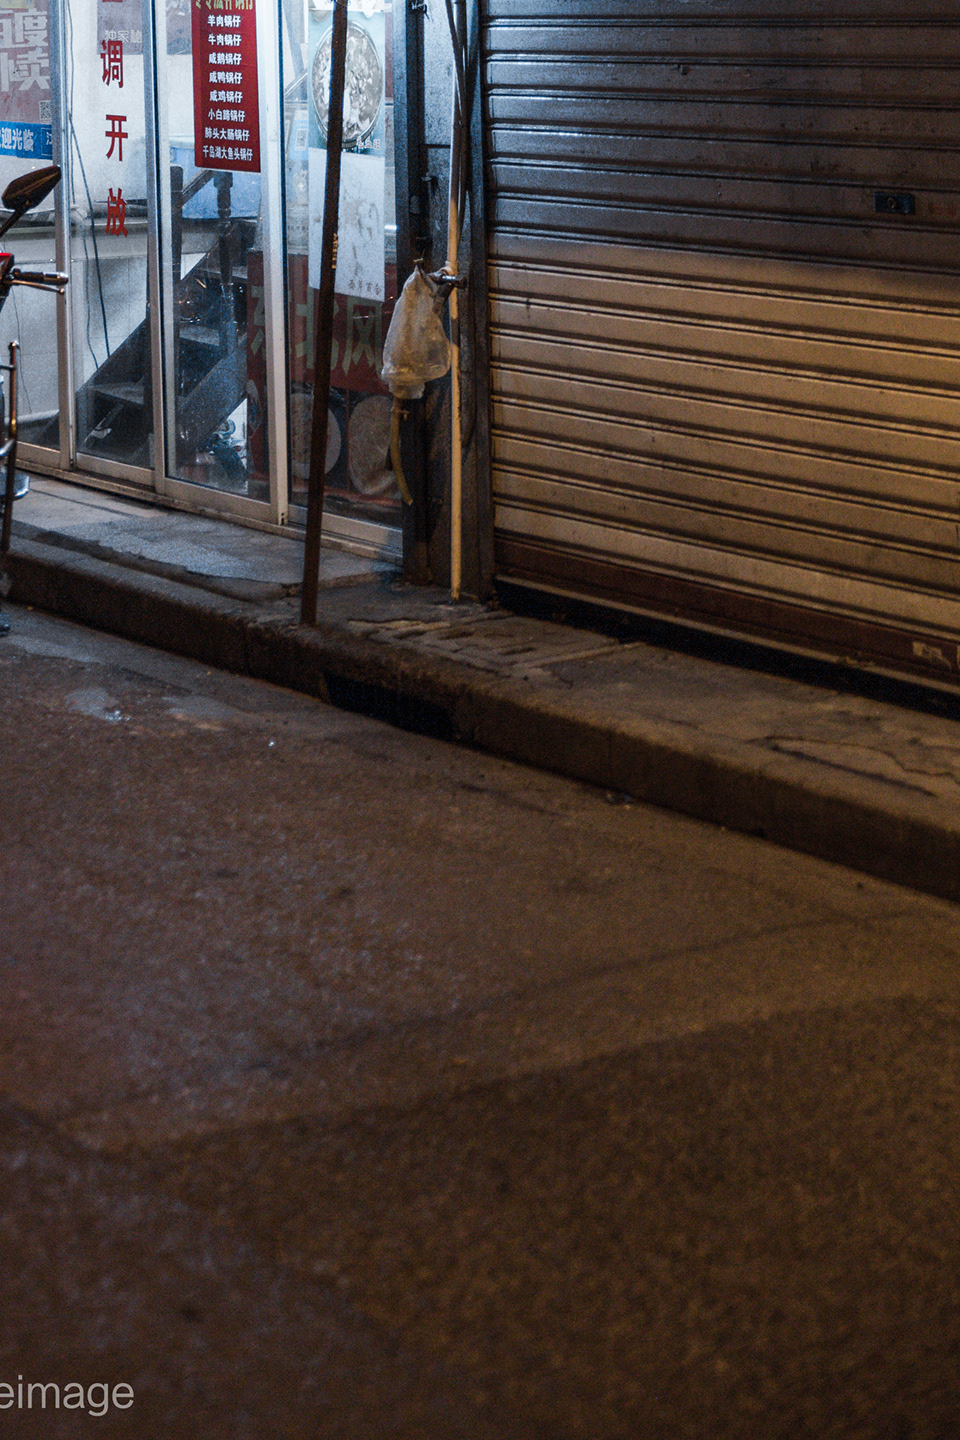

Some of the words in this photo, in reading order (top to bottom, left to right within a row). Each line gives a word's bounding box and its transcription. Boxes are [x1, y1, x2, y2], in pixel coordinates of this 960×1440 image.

[207, 14, 241, 27] 羊肉锅仔
[208, 33, 242, 46] 牛肉锅仔
